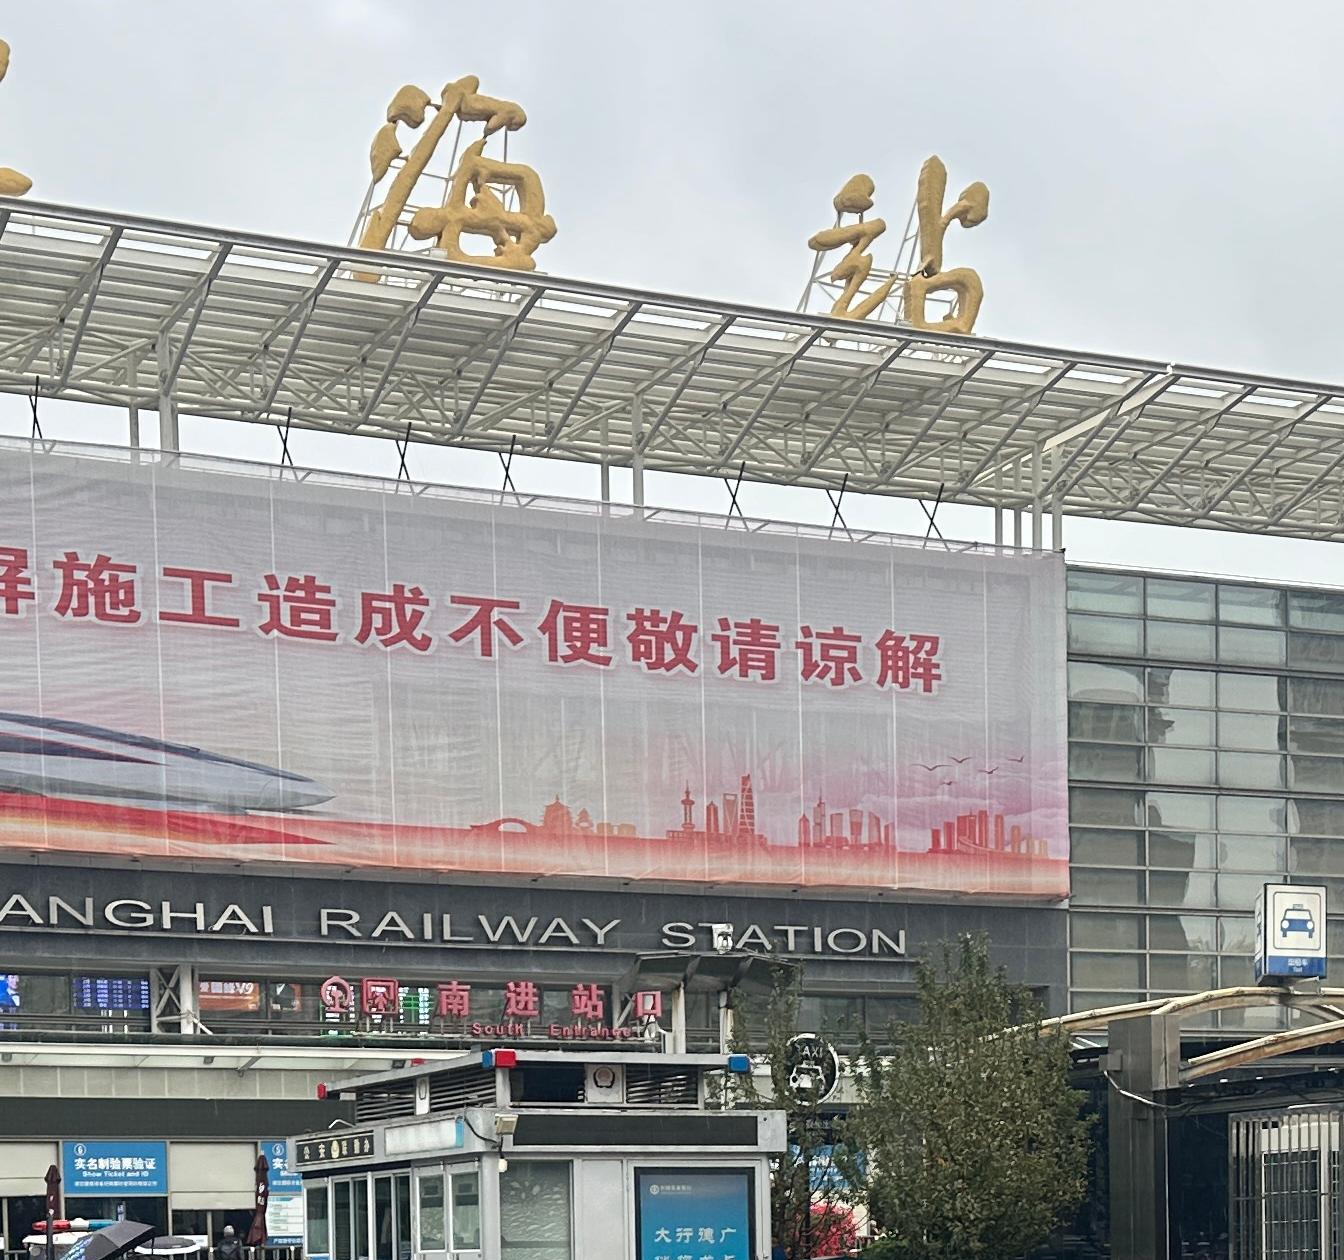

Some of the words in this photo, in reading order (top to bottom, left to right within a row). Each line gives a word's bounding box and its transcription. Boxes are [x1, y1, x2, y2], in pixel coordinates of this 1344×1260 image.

[320, 908, 621, 945] RAILWAY
[438, 980, 662, 1019] 南进站口
[472, 1022, 525, 1035] South
